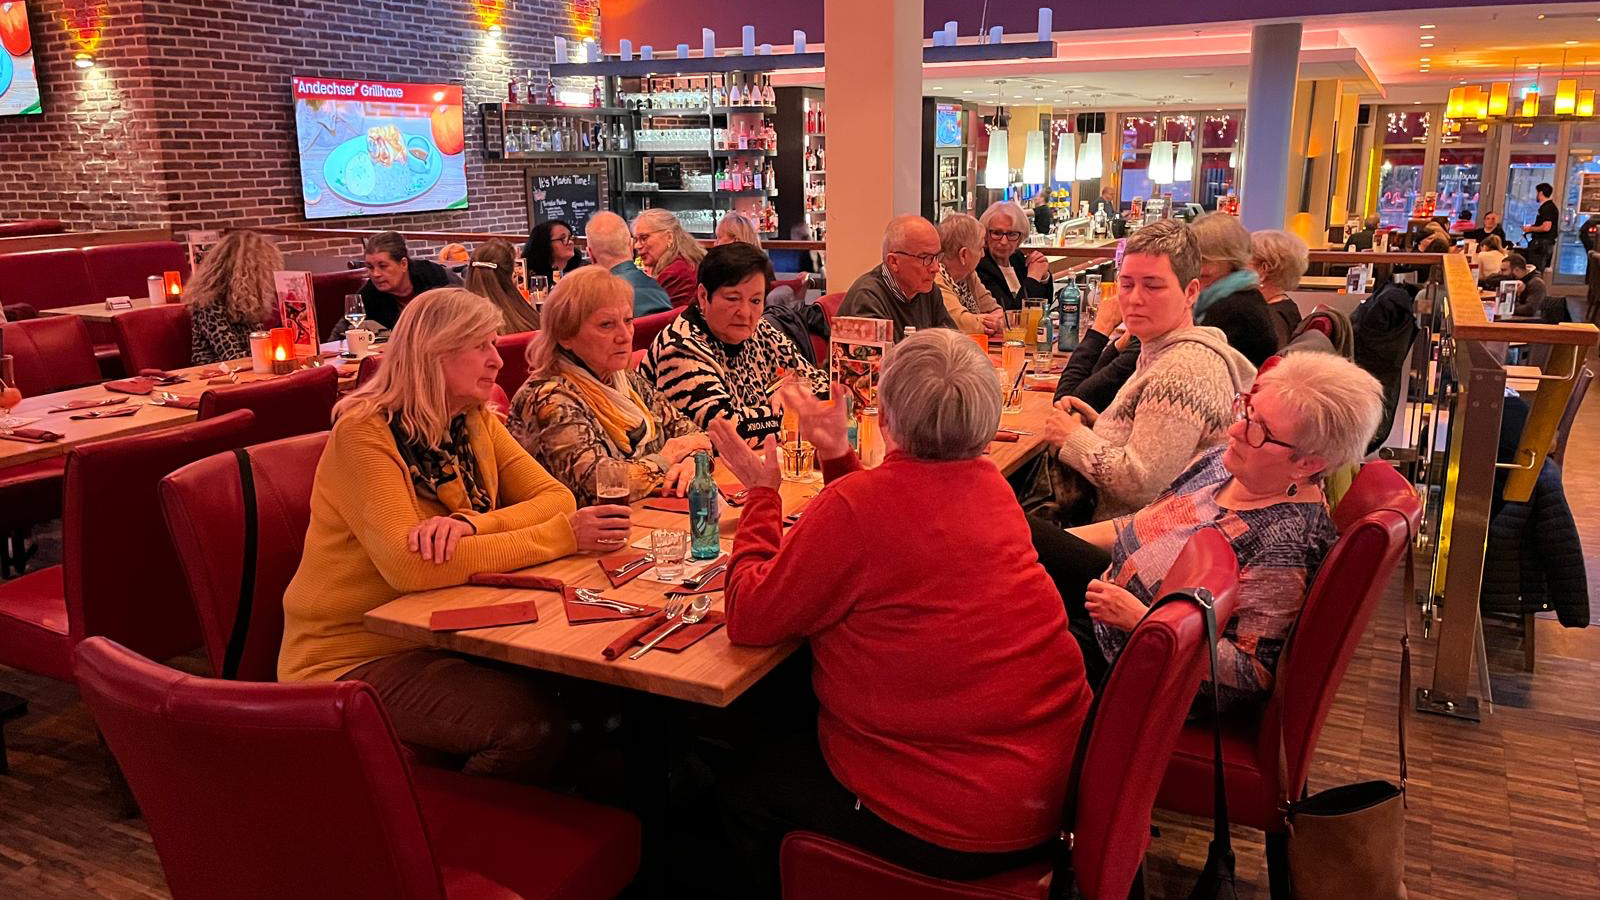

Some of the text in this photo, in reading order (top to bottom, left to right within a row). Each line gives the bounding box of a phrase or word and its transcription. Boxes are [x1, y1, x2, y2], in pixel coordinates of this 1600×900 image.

[360, 84, 404, 98] Grillhaxe
[538, 176, 550, 189] It's
[747, 420, 779, 432] NEW YORK
